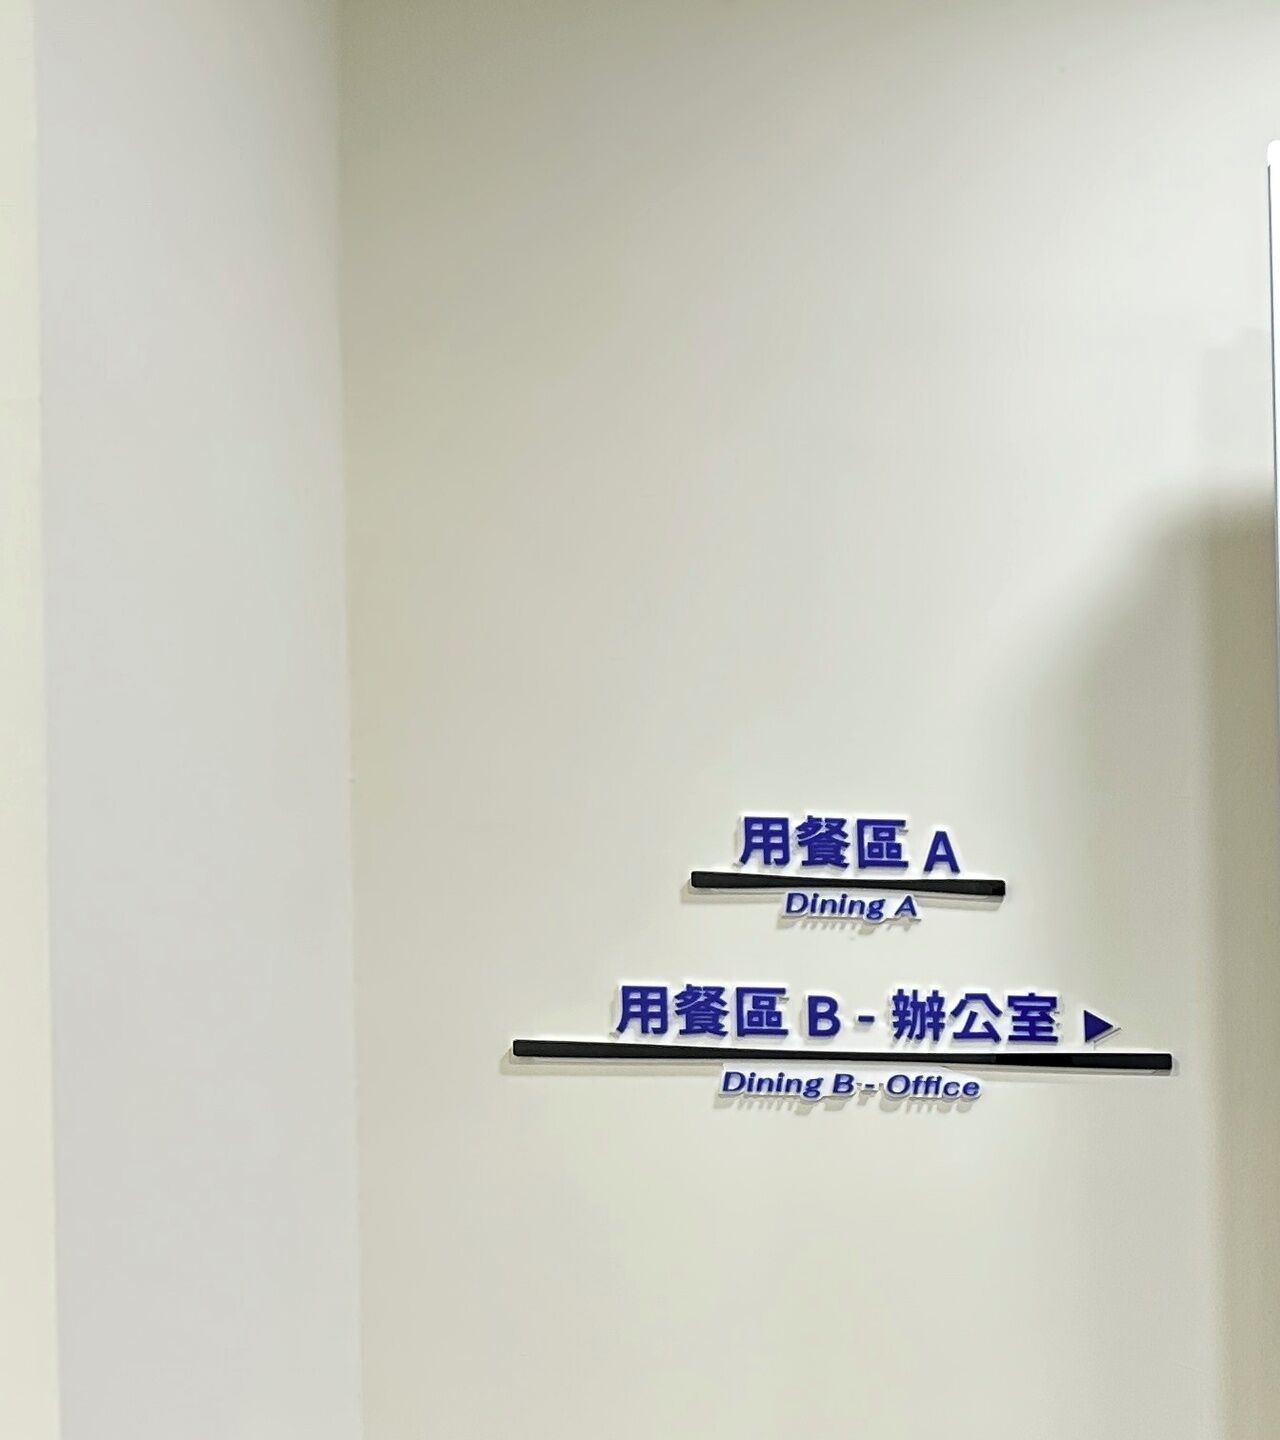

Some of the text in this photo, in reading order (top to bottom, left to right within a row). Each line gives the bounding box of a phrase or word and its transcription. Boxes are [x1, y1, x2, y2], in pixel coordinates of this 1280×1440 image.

[740, 816, 960, 873] 用餐區 A
[786, 892, 917, 920] Dining A
[616, 984, 788, 1037] 用餐區
[808, 995, 841, 1037] B
[892, 989, 1059, 1043] 辦公室
[722, 1071, 824, 1098] Dining
[833, 1074, 855, 1094] B
[886, 1074, 980, 1097] Office
